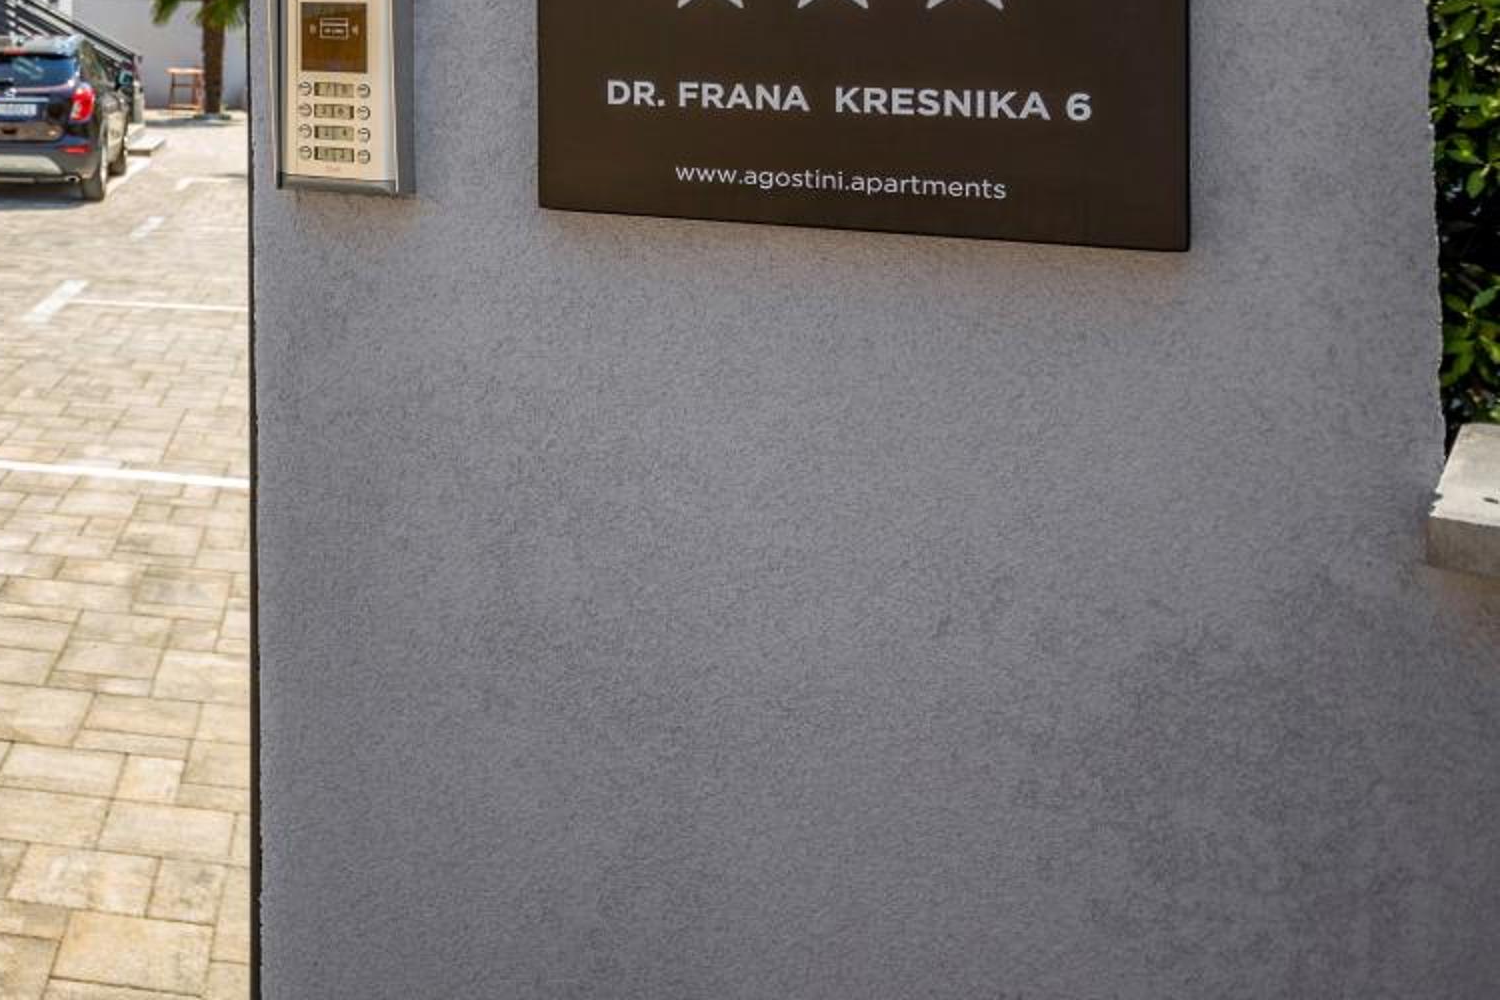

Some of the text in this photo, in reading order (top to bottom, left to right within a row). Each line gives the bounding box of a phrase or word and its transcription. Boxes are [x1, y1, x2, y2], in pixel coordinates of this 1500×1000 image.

[607, 79, 1092, 121] DR. FRANA KRESNIKA 6
[675, 166, 1007, 199] www.agostini.apartments
